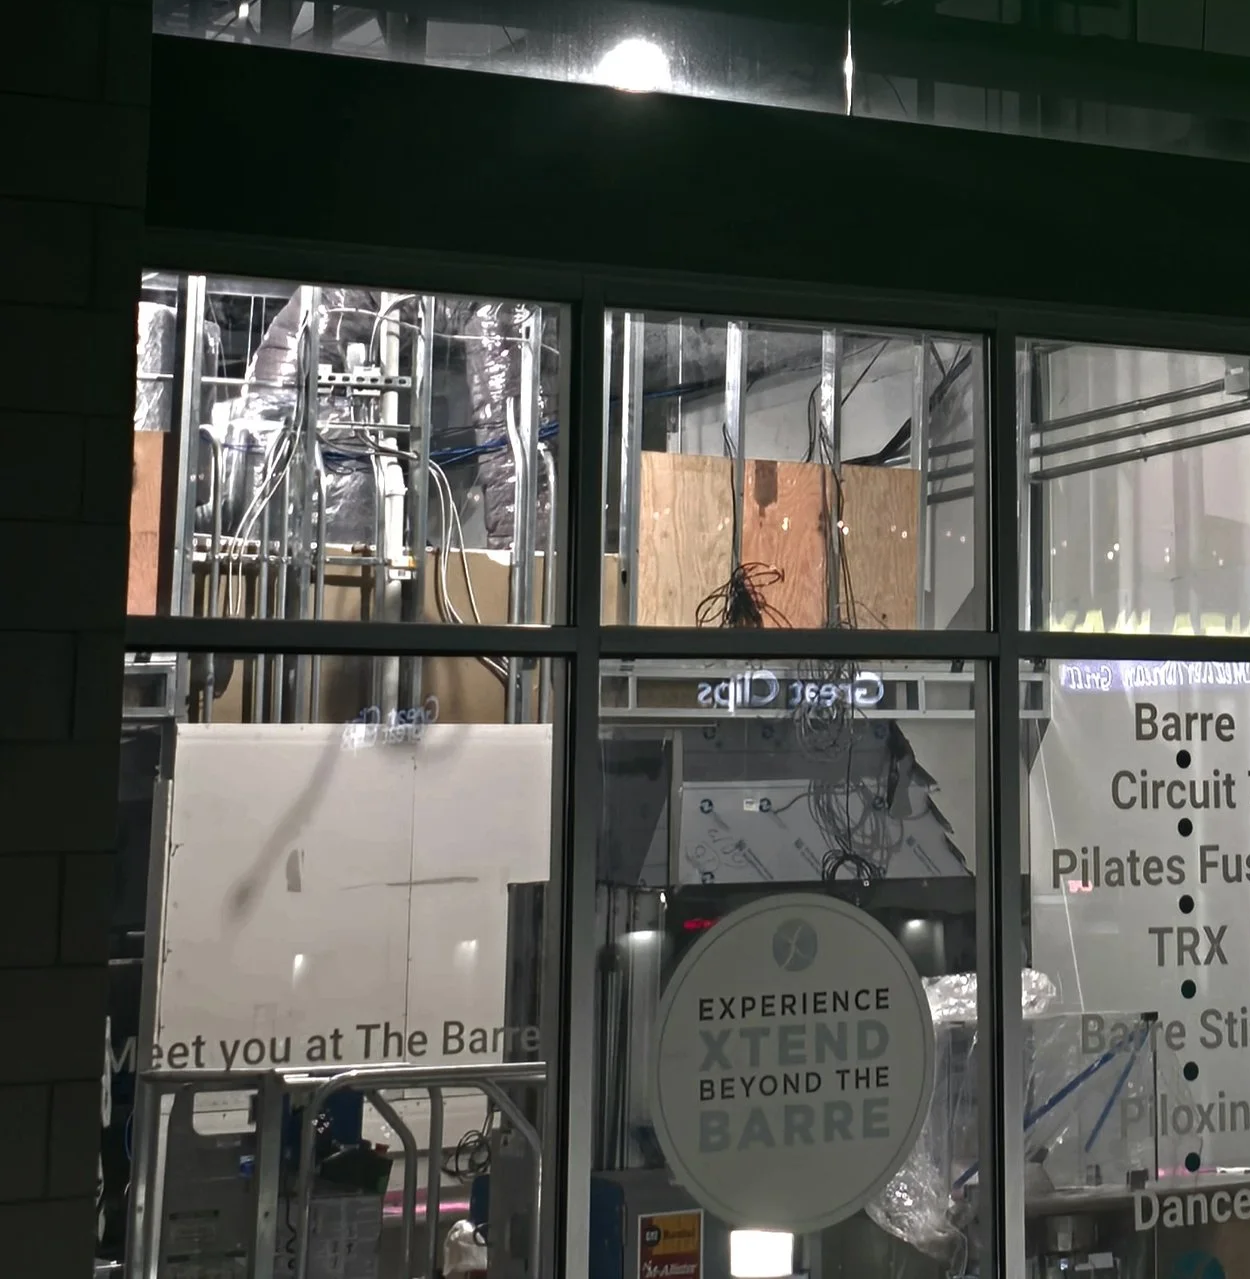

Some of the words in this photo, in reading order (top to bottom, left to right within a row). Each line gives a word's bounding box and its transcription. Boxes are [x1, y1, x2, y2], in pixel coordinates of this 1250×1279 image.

[1135, 702, 1236, 742] Barre
[1111, 769, 1236, 809] Circuit
[1052, 846, 1186, 889] Pilates
[1148, 925, 1229, 967] TRX
[699, 987, 890, 1021] EXPERIENCE
[219, 1036, 291, 1072] you
[306, 1028, 343, 1061] at
[356, 1021, 428, 1058] The
[442, 1021, 541, 1056] Barre
[699, 1020, 890, 1072] XTEND
[1081, 1012, 1186, 1055] Barre
[699, 1071, 822, 1101] BEYOND
[836, 1065, 890, 1091] THE
[699, 1096, 890, 1154] BARRE
